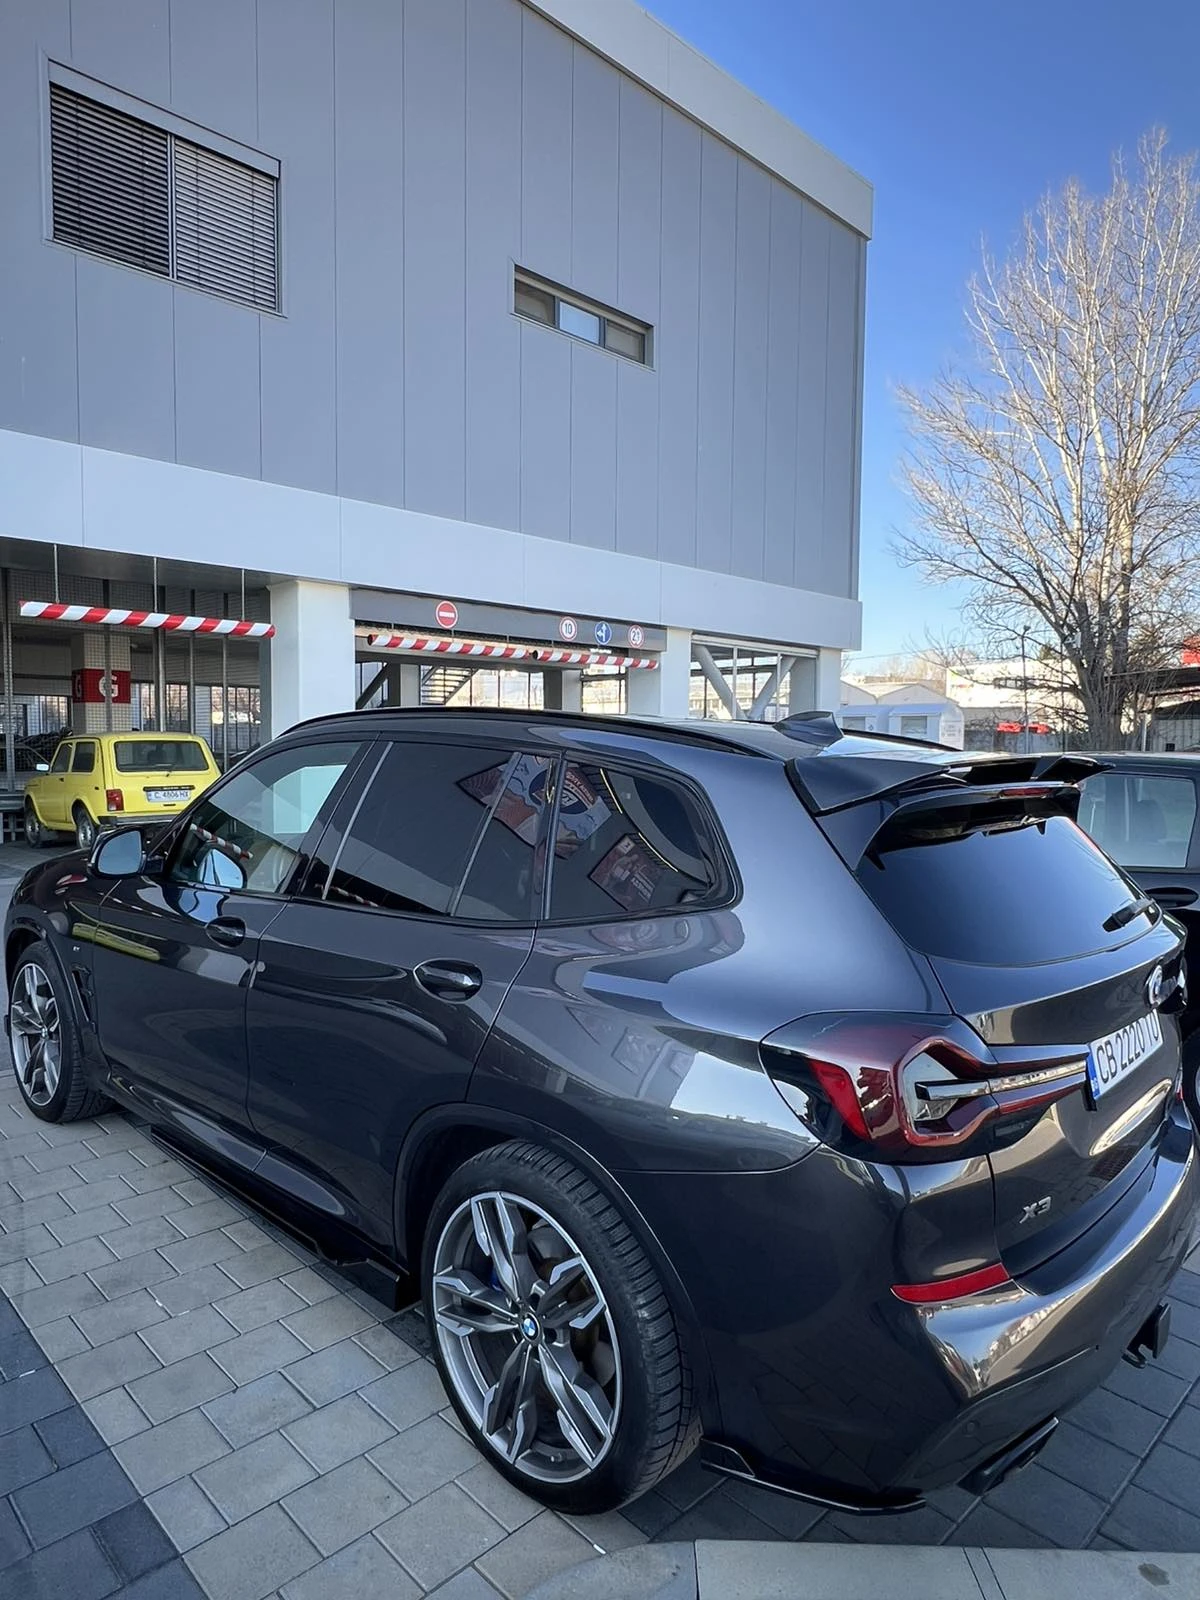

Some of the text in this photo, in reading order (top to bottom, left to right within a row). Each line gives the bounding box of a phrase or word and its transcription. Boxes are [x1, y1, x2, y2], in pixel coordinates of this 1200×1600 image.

[564, 622, 573, 635] 10
[98, 675, 119, 697] G
[1096, 1039, 1118, 1084] CB
[1115, 1020, 1146, 1071] 2220
[1019, 1195, 1052, 1224] X3
